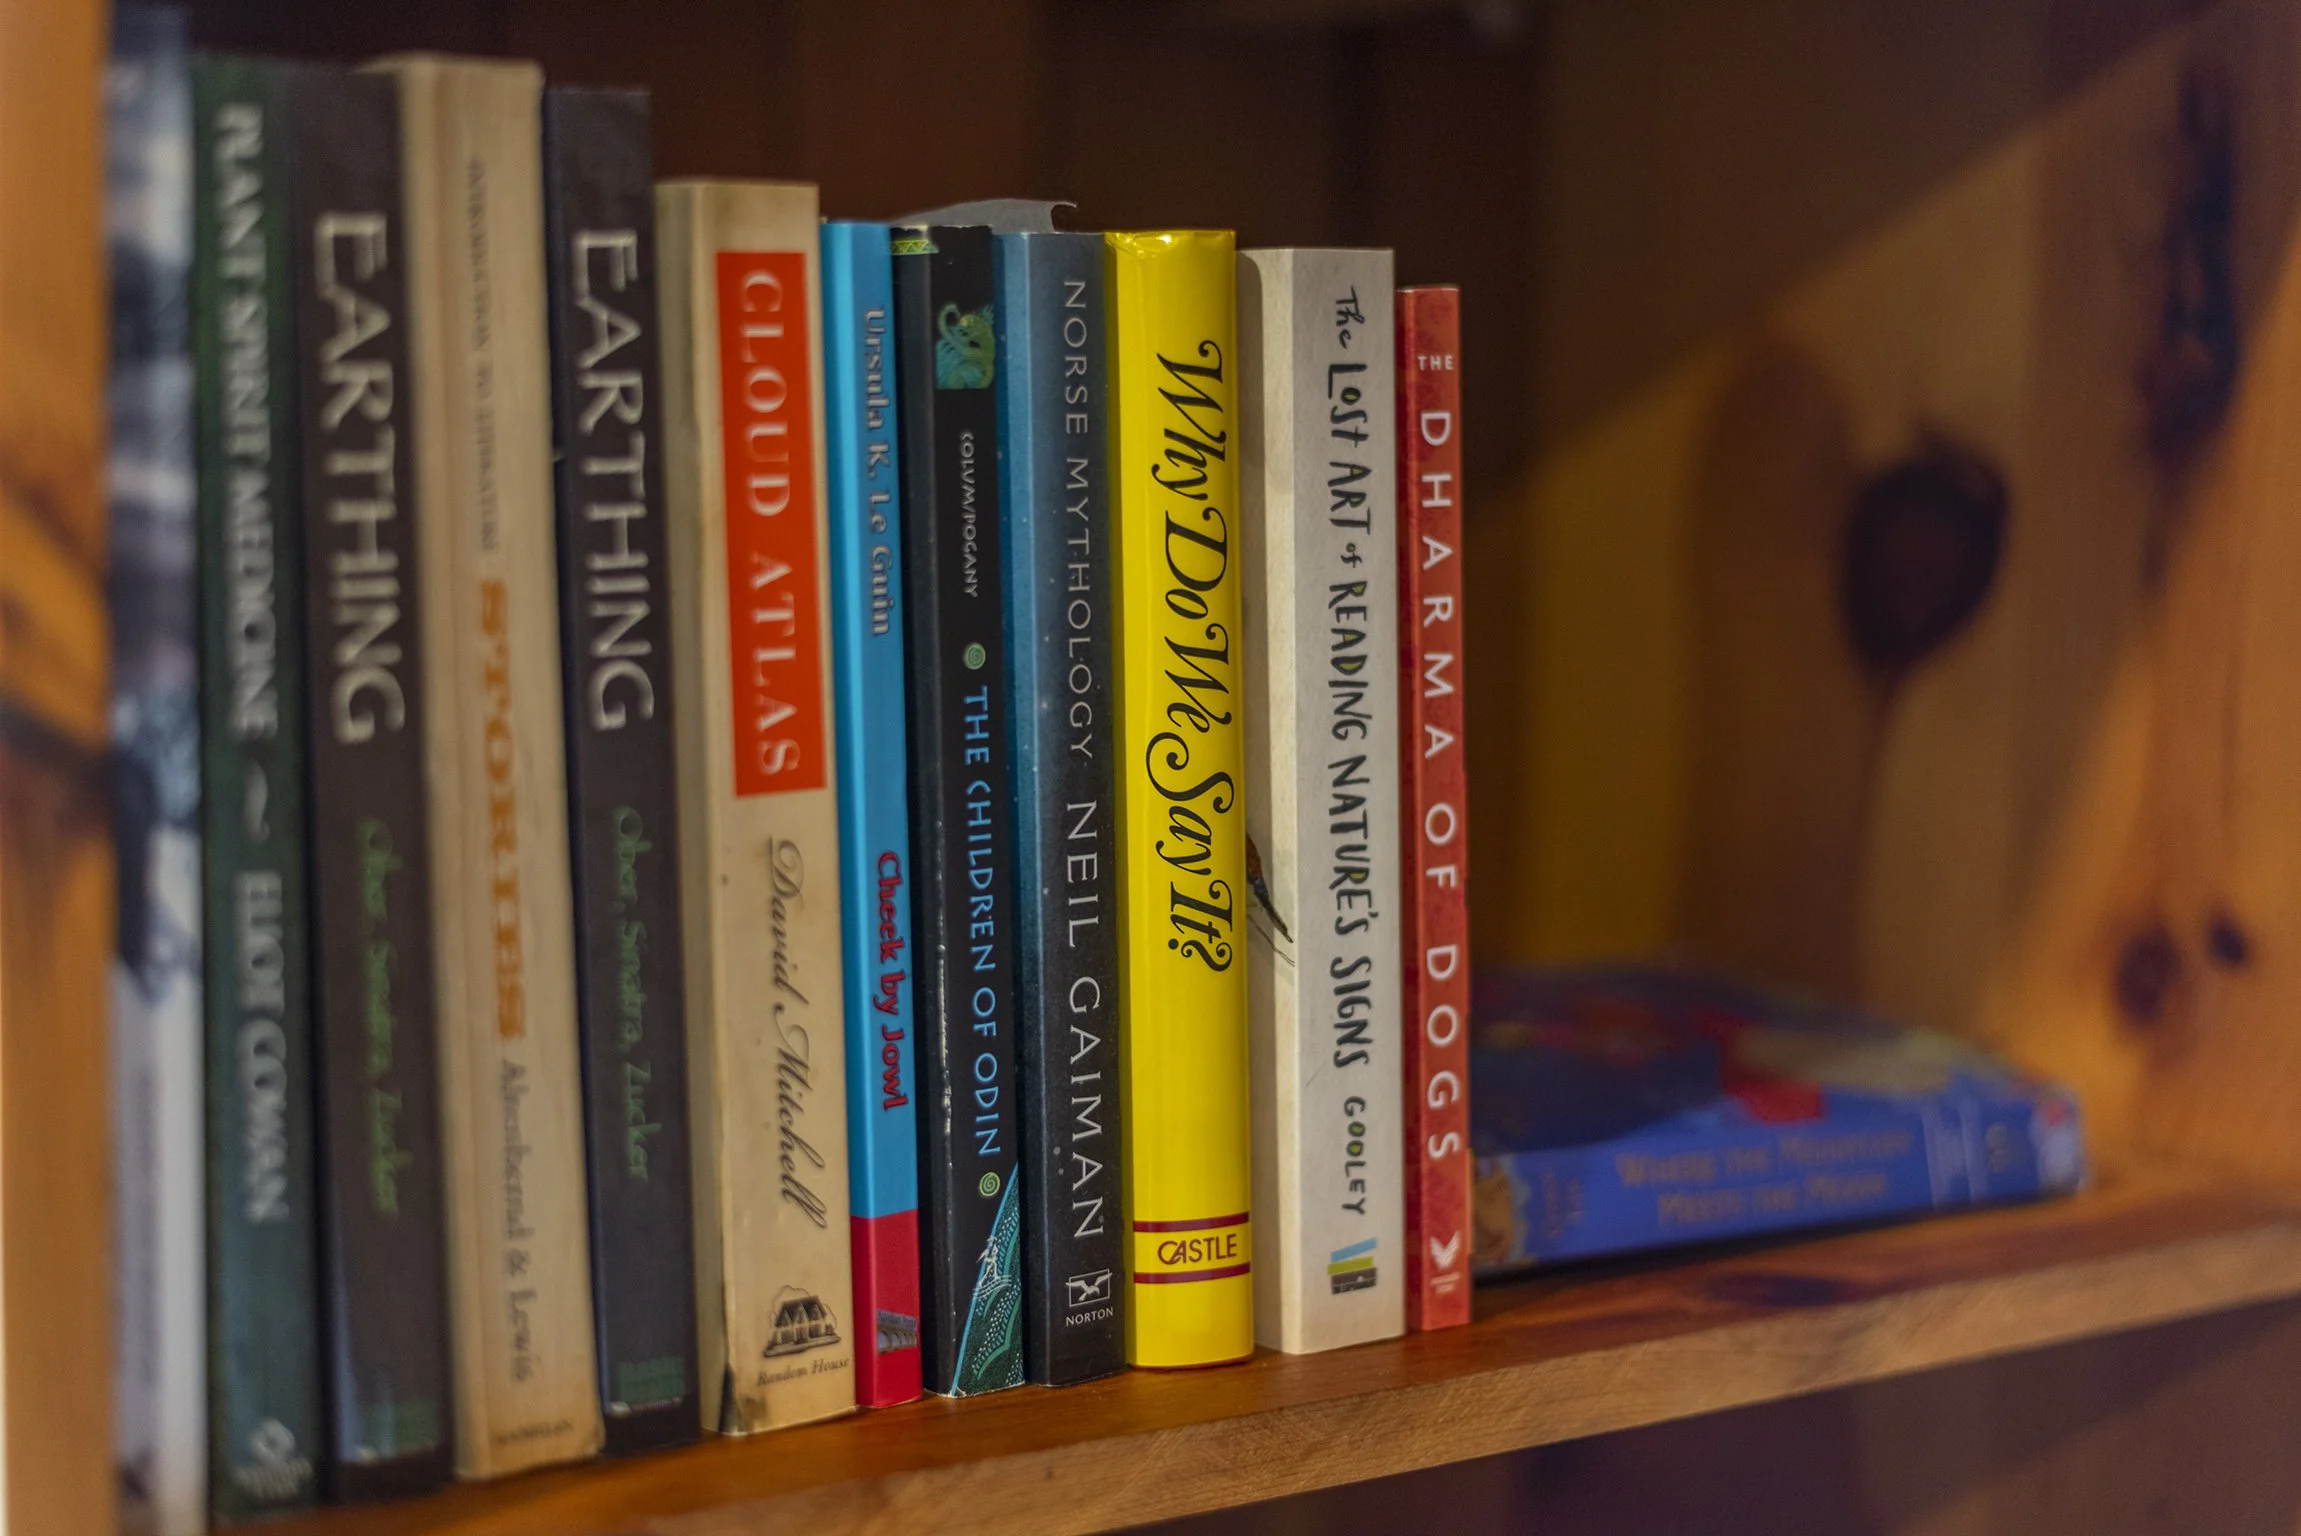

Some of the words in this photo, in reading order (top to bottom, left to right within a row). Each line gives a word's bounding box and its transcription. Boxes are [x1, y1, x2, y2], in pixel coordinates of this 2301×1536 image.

[863, 307, 892, 430] Ursula
[1064, 280, 1088, 435] NORSE
[1335, 286, 1366, 349] The
[1417, 353, 1454, 371] THE
[741, 268, 792, 518] CLOUD
[1152, 340, 1226, 500] Why
[1327, 364, 1369, 450] LOST
[314, 212, 406, 744] EARTHING
[573, 229, 655, 732] EARTHING
[867, 441, 892, 482] K.
[868, 491, 892, 533] Le
[1328, 462, 1370, 536] ART
[869, 545, 894, 637] Guin
[1066, 457, 1095, 760] MYTHOLOGY
[1164, 506, 1228, 620] Do
[1340, 542, 1362, 568] of
[1420, 410, 1455, 760] DHARMA
[749, 553, 799, 775] ATLAS
[1165, 623, 1232, 733] We
[1329, 579, 1369, 741] READING
[963, 686, 990, 766] THE
[481, 578, 527, 1041] STORIES
[1146, 732, 1236, 876] Say
[1328, 754, 1379, 936] NATURE'S
[1424, 801, 1457, 888] OF
[768, 836, 804, 1004] David
[875, 850, 905, 963] Cheek
[965, 779, 998, 971] CHILDREN
[1066, 802, 1098, 948] NEIL
[1168, 873, 1233, 973] It?
[874, 972, 906, 1018] by
[971, 987, 998, 1038] OF
[1330, 957, 1373, 1068] SIGNS
[879, 1026, 909, 1113] Jowl
[972, 1057, 1000, 1156] ODIN
[1069, 976, 1104, 1238] GAIMAN
[1425, 944, 1459, 1161] DOGS
[623, 1060, 663, 1184] Zucker
[775, 1003, 828, 1230] Mitchell
[1341, 1096, 1368, 1216] GOOLEY
[1157, 1234, 1237, 1265] CASTLE
[757, 1365, 807, 1386] Random
[812, 1357, 849, 1375] House
[1065, 1306, 1114, 1326] NORTON
